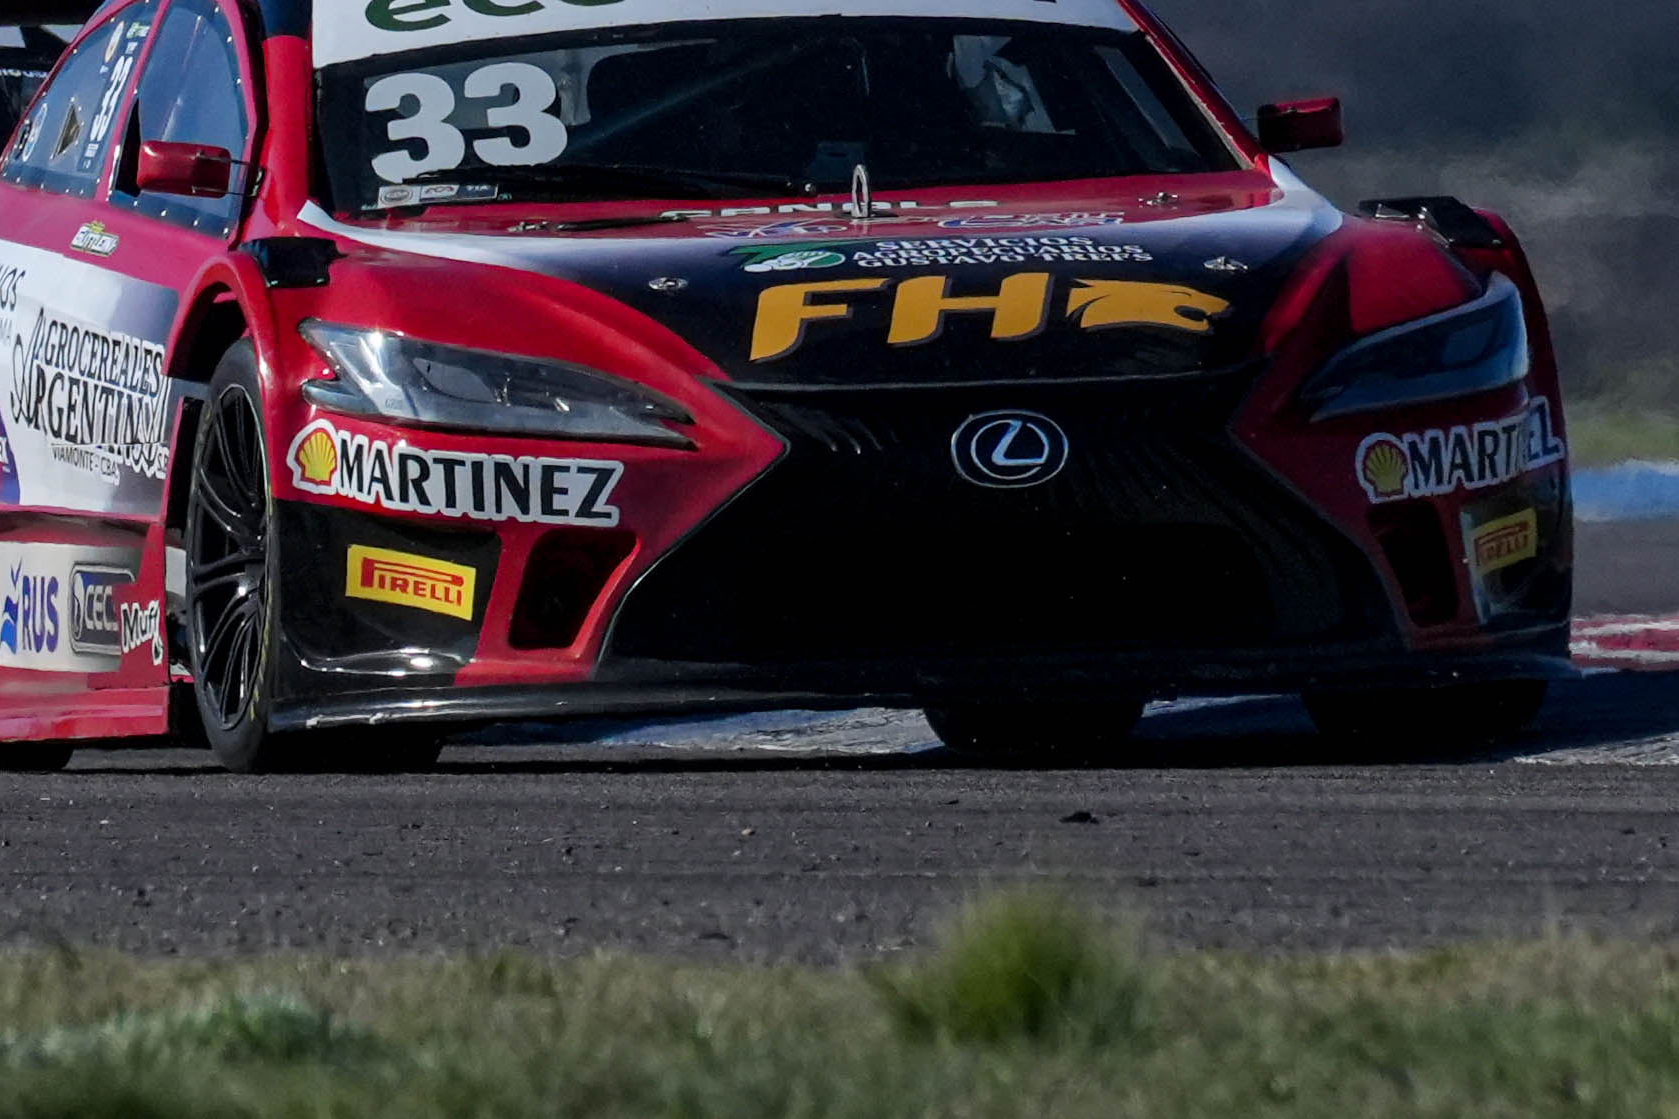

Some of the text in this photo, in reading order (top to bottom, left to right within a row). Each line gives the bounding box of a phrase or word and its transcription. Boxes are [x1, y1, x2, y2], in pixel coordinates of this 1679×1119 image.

[365, 62, 568, 182] 33
[852, 244, 1144, 261] AGROPECUARIOS
[857, 254, 1026, 268] GUSTAVO
[875, 236, 1094, 251] SERVICIOS
[29, 306, 165, 409] AGROCEREALES
[339, 436, 617, 520] MARTINEZ
[22, 575, 60, 653] RUS
[361, 556, 465, 608] PIRELLI
